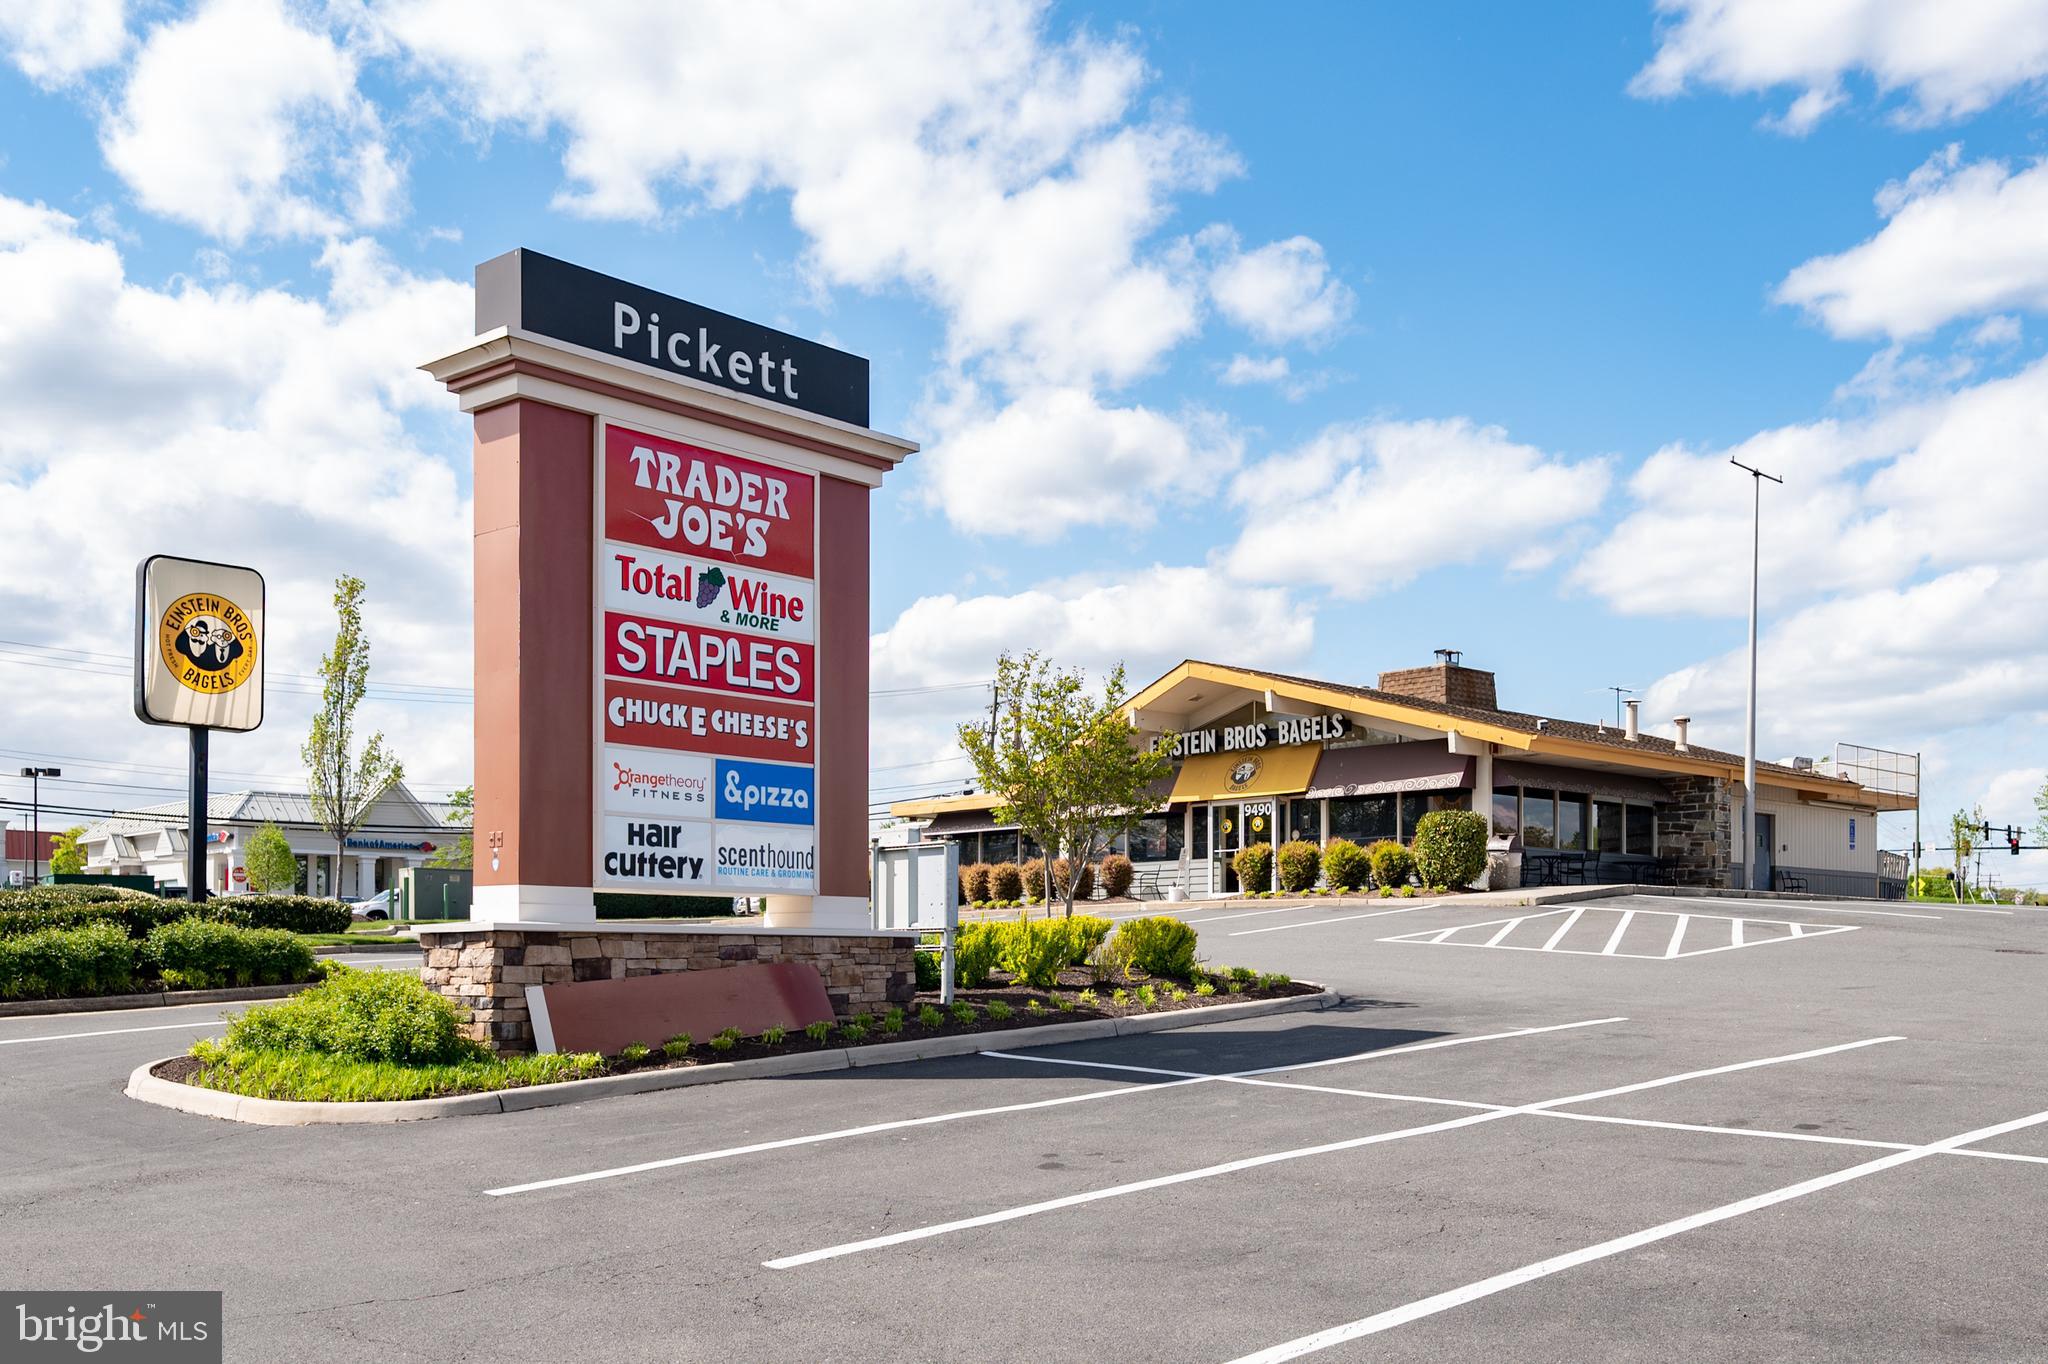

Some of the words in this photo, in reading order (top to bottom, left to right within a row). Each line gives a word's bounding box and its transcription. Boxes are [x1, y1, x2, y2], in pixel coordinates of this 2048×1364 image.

[613, 300, 799, 400] Pickett
[629, 445, 791, 521] TRADER
[650, 498, 772, 559] JOE'S
[614, 554, 692, 603] Total
[727, 575, 804, 622] Wine
[166, 597, 220, 631] EINSTEIN
[223, 606, 252, 641] BROS
[720, 610, 730, 624] &
[735, 612, 779, 632] MORE
[616, 620, 802, 695] STAPLES
[183, 668, 234, 689] BAGELS
[607, 695, 688, 728] CHUCK
[691, 706, 707, 737] E
[711, 708, 809, 749] CHEESE'S
[1149, 729, 1216, 757] ESTEIN
[1224, 723, 1267, 751] BROS
[1277, 713, 1344, 745] BAGELS
[614, 764, 705, 792] Orangetheory
[632, 788, 705, 803] FITNESS
[724, 769, 809, 811] &pizza
[1244, 803, 1272, 817] 9490
[627, 822, 682, 849] Hair
[604, 851, 703, 880] cuttery
[718, 843, 814, 870] scenthound
[718, 867, 750, 876] ROUTINE
[751, 868, 769, 878] CARE
[771, 869, 776, 878] &
[777, 869, 814, 879] GROOMING
